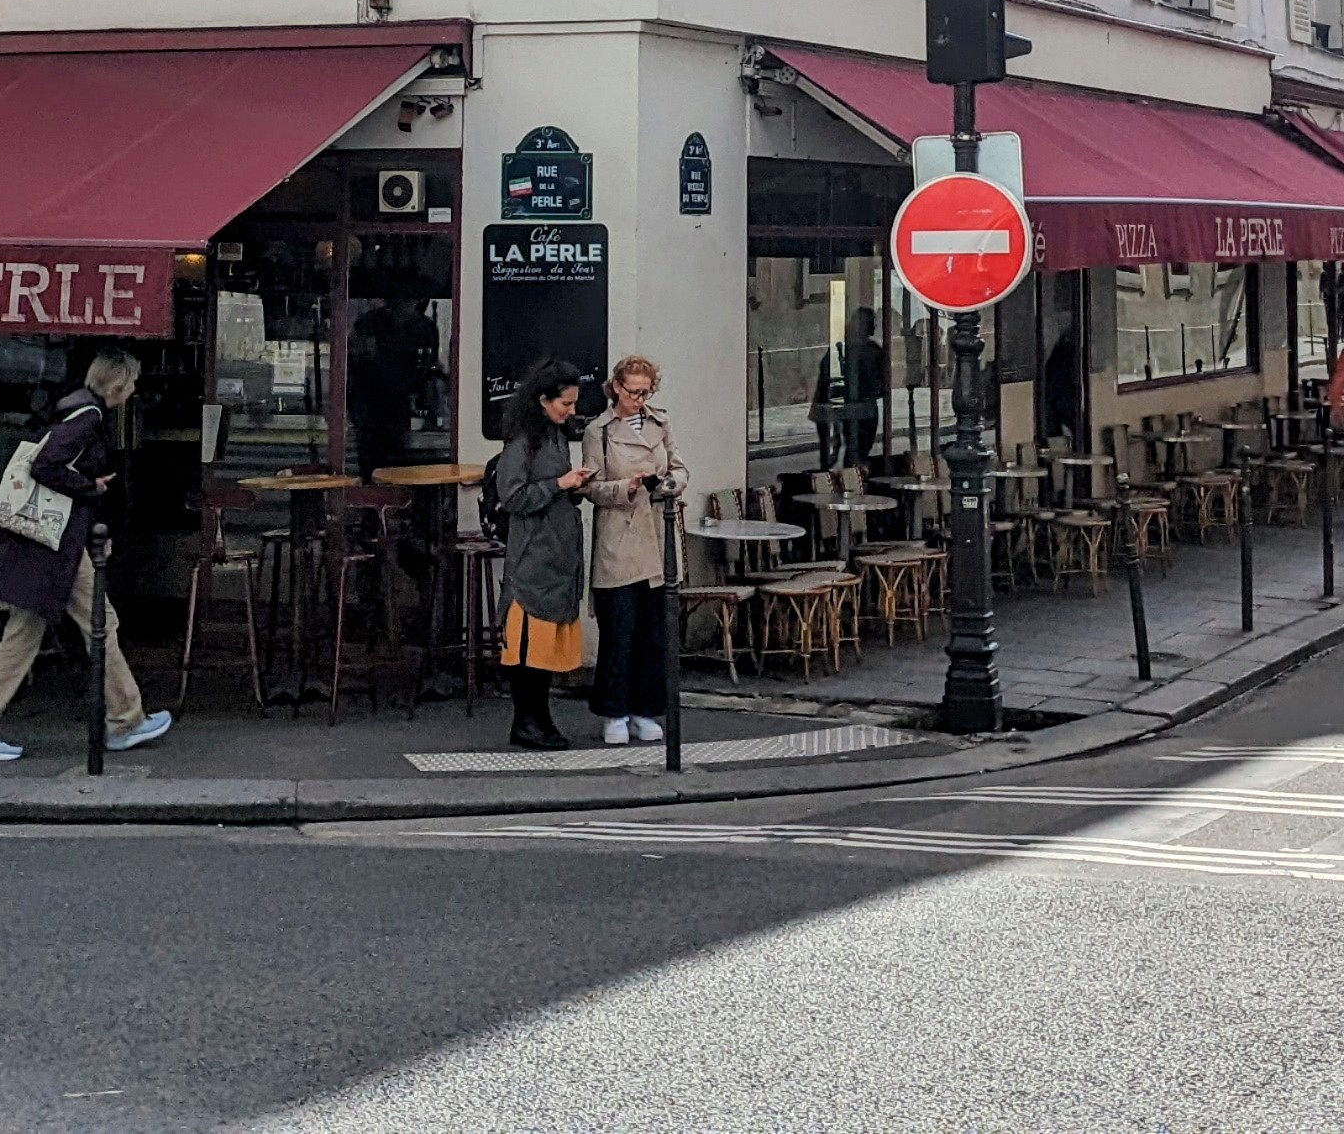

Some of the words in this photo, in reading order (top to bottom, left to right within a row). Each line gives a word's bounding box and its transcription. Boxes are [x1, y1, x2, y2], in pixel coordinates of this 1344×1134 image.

[536, 165, 558, 178] RUE
[531, 195, 563, 208] PERLE
[1115, 224, 1158, 258] PIZZA
[1215, 217, 1237, 257] LA
[1239, 218, 1285, 257] PERLE
[489, 243, 525, 262] LA
[530, 243, 602, 262] PERLE
